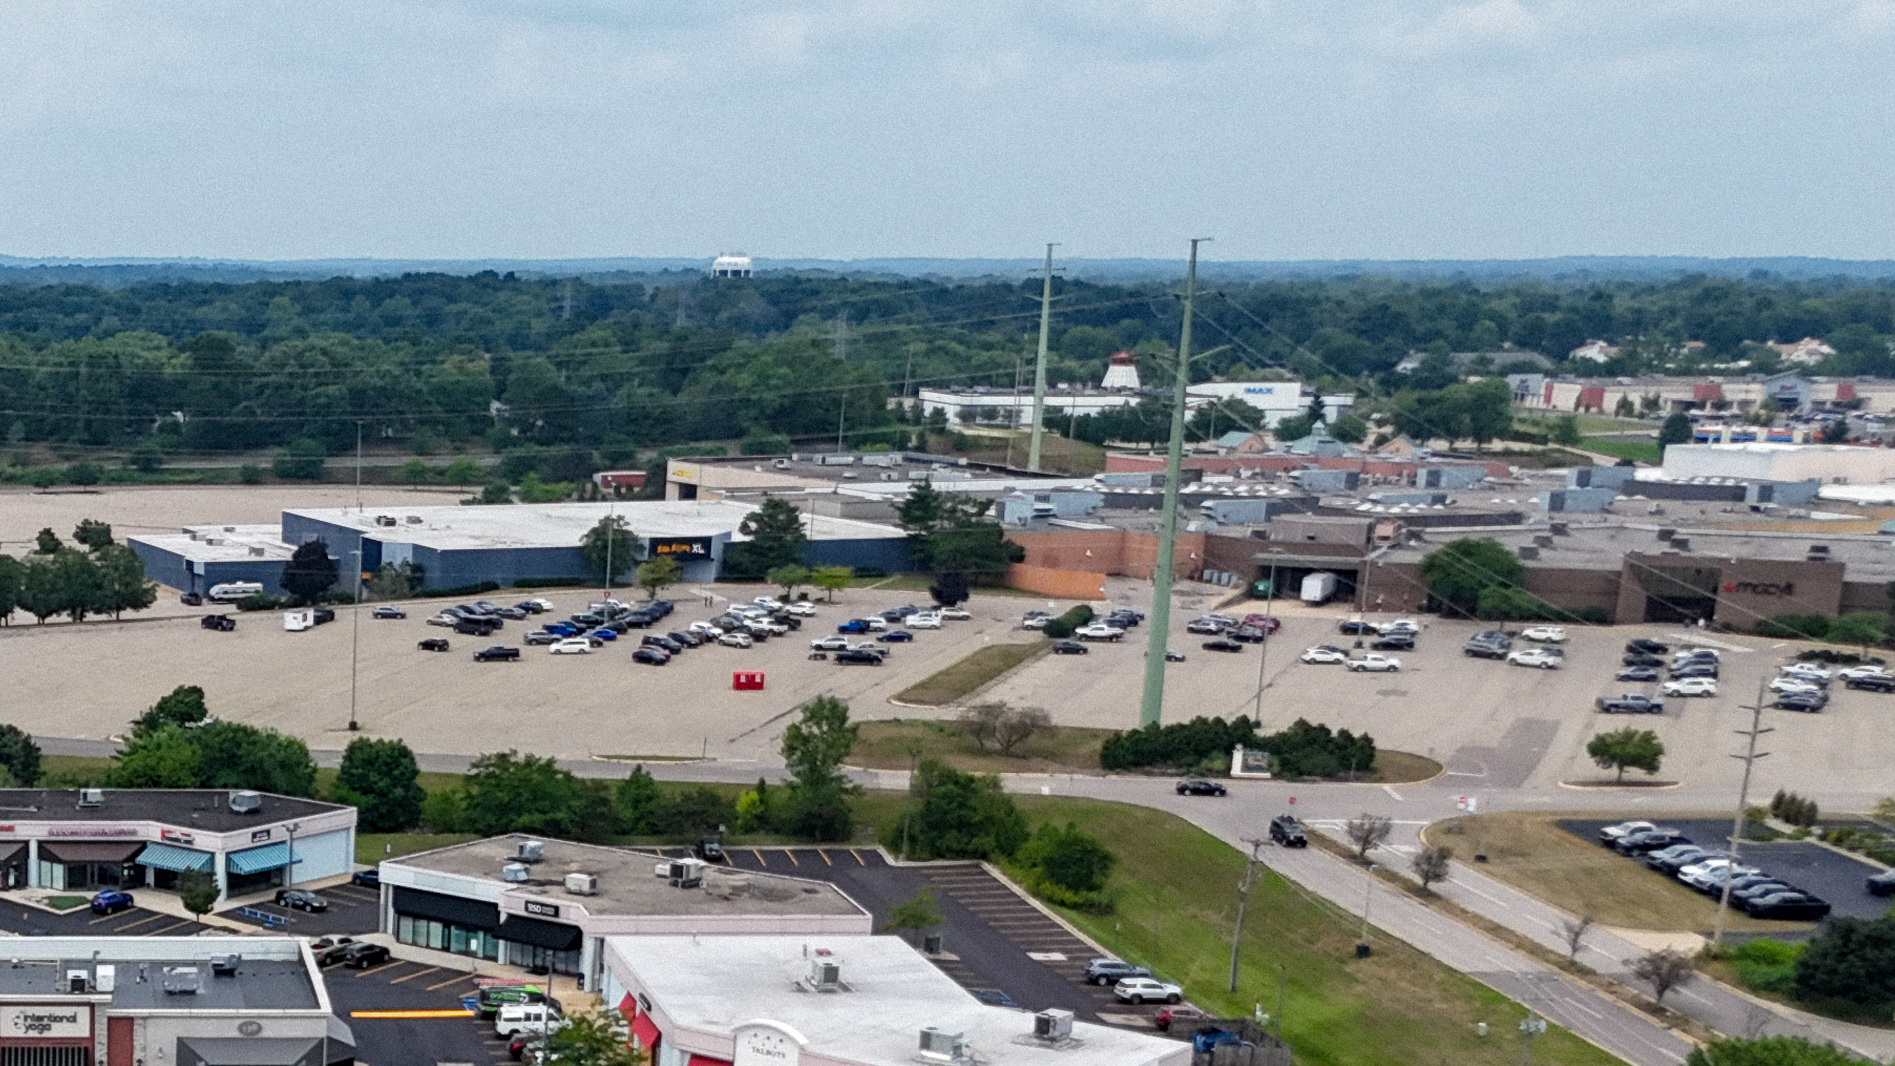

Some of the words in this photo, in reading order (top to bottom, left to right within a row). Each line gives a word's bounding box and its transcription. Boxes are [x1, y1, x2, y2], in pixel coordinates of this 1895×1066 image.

[23, 1011, 77, 1023] intentional
[23, 1022, 52, 1034] yoga
[752, 1046, 786, 1059] TALBOTS
